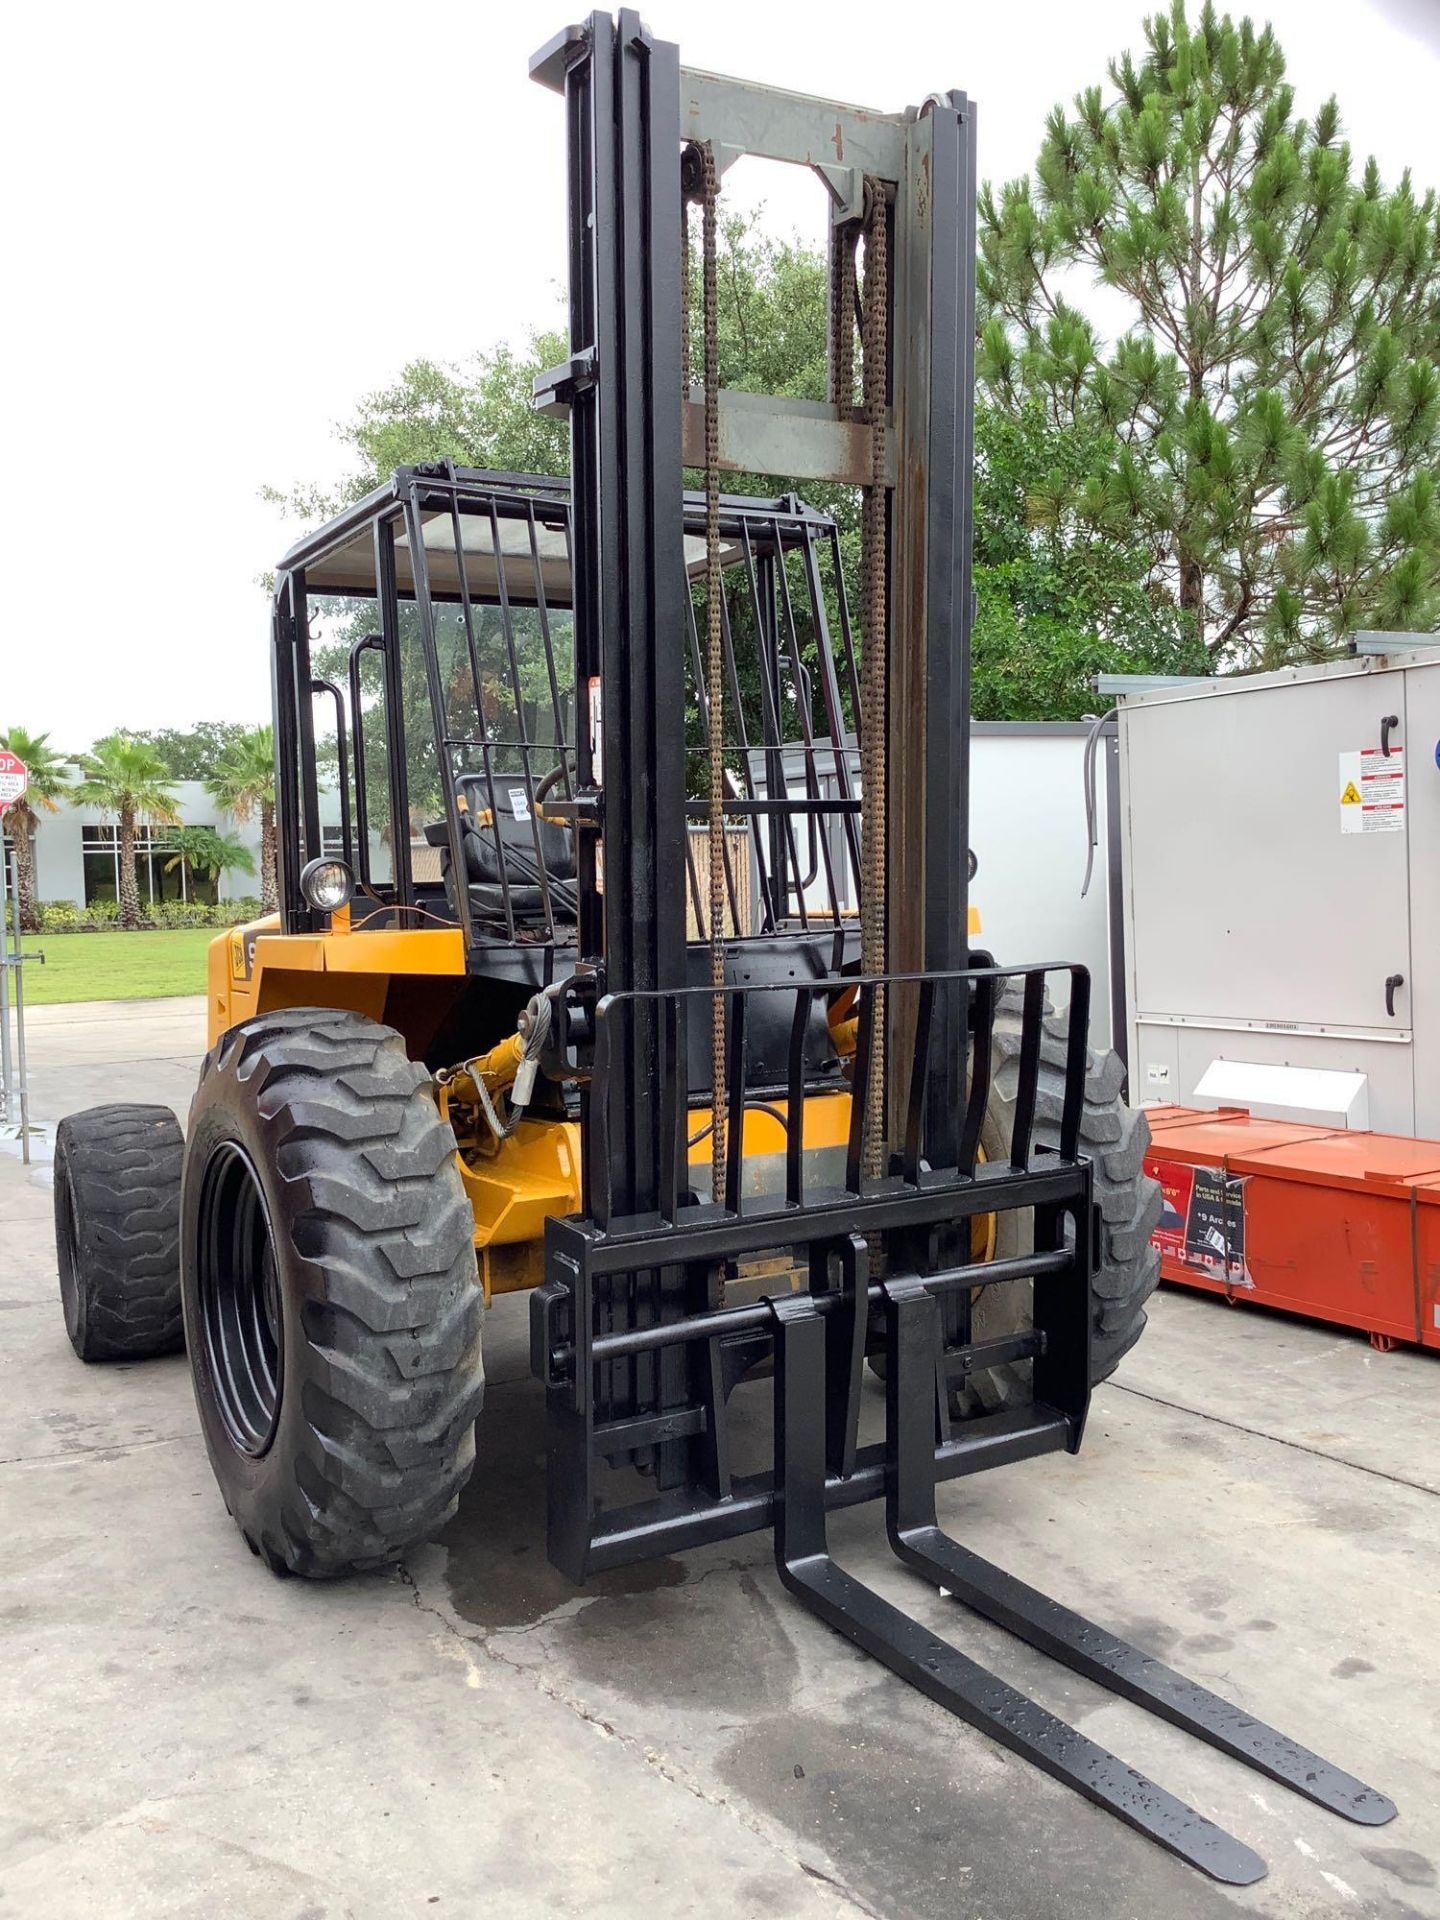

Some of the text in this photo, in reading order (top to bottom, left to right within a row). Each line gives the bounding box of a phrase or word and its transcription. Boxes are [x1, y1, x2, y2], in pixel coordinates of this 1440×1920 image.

[0, 758, 15, 771] OP
[1202, 1193, 1215, 1202] USA
[1209, 1214, 1236, 1228] Arces
